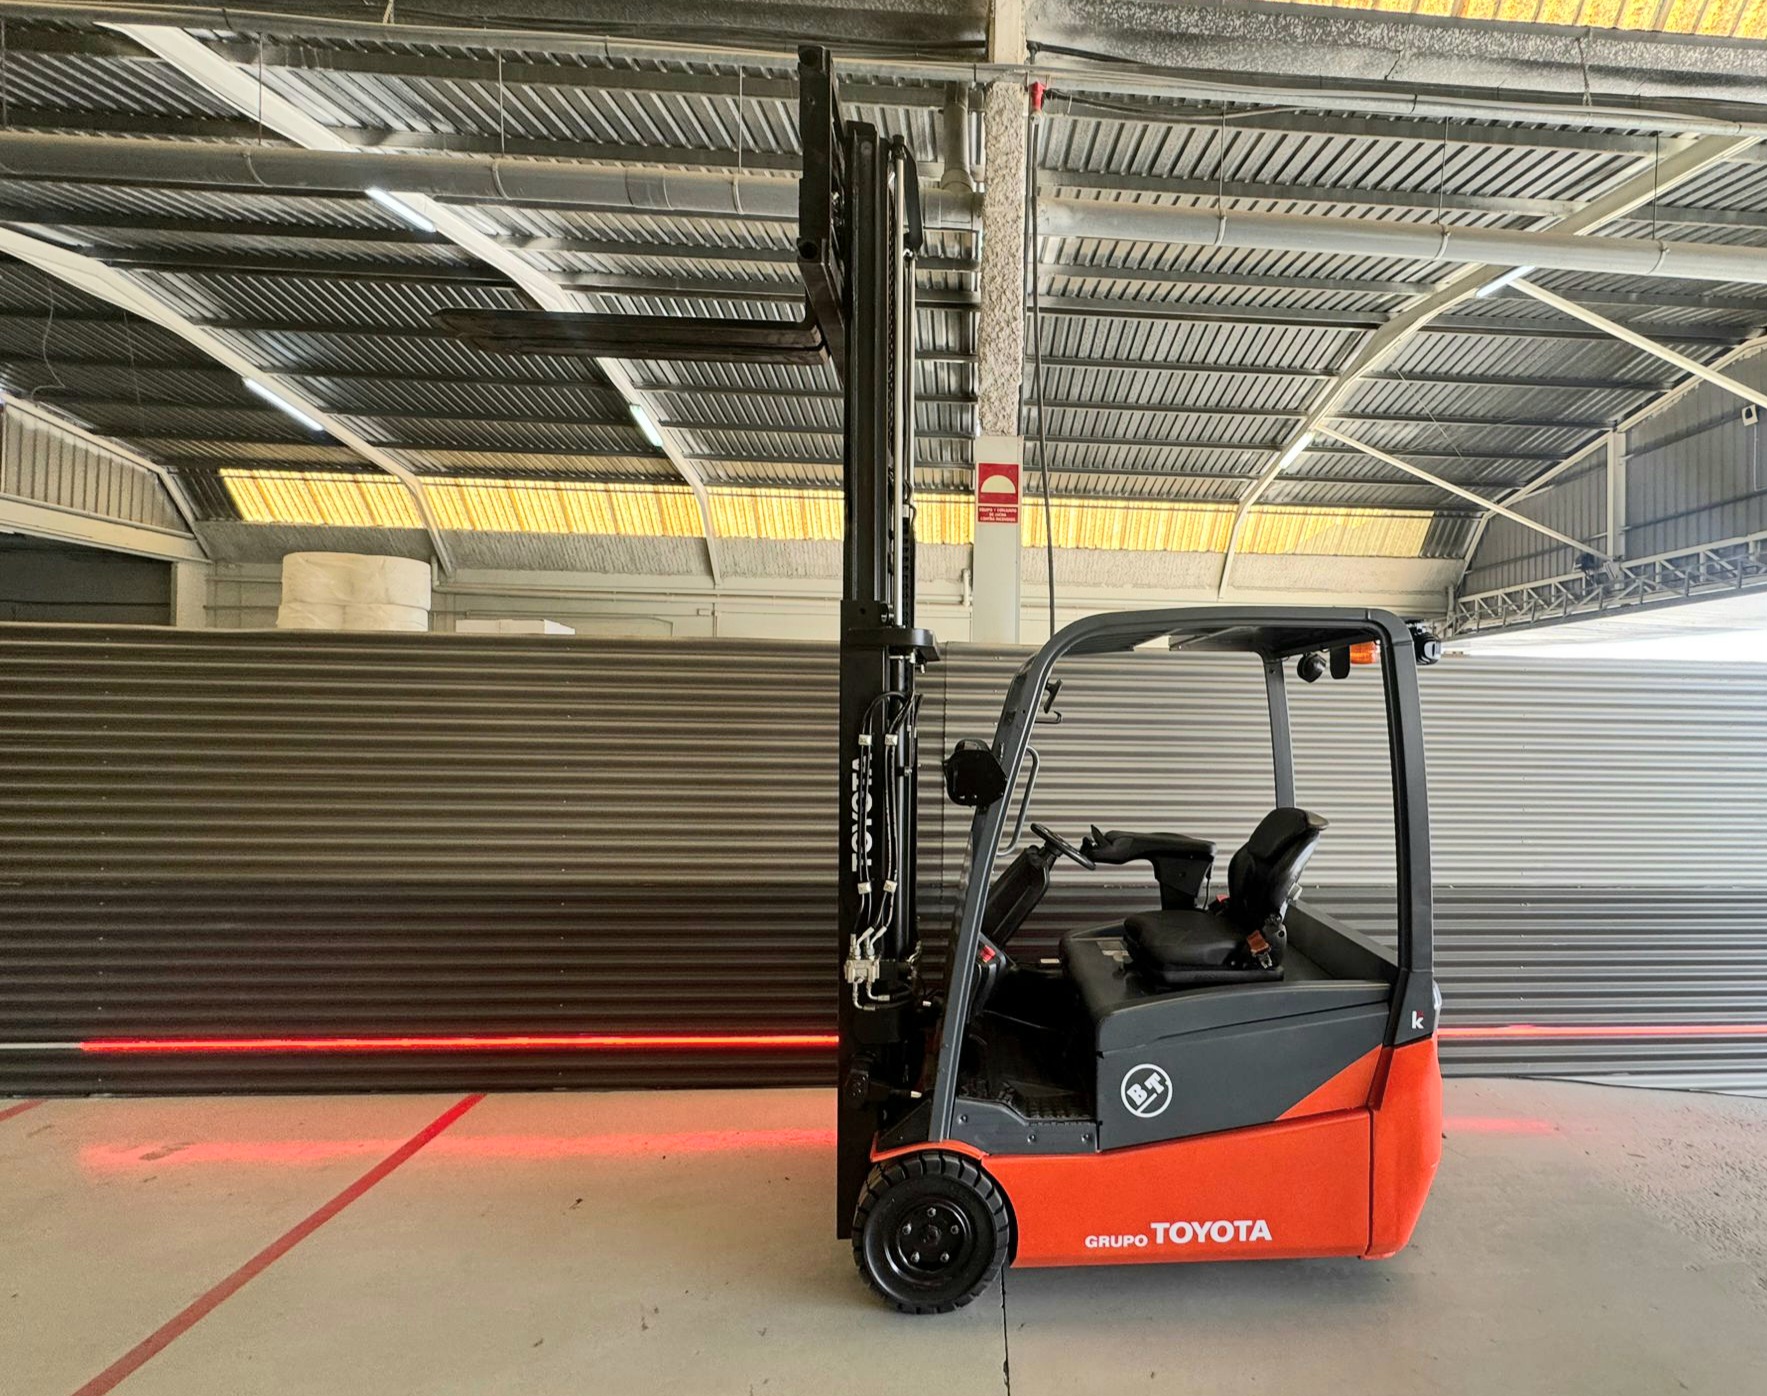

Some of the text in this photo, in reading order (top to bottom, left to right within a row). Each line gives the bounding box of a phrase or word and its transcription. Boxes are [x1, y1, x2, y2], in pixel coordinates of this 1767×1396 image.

[1126, 1071, 1165, 1106] BT
[1084, 1219, 1273, 1248] GRUPO TOYOTA
